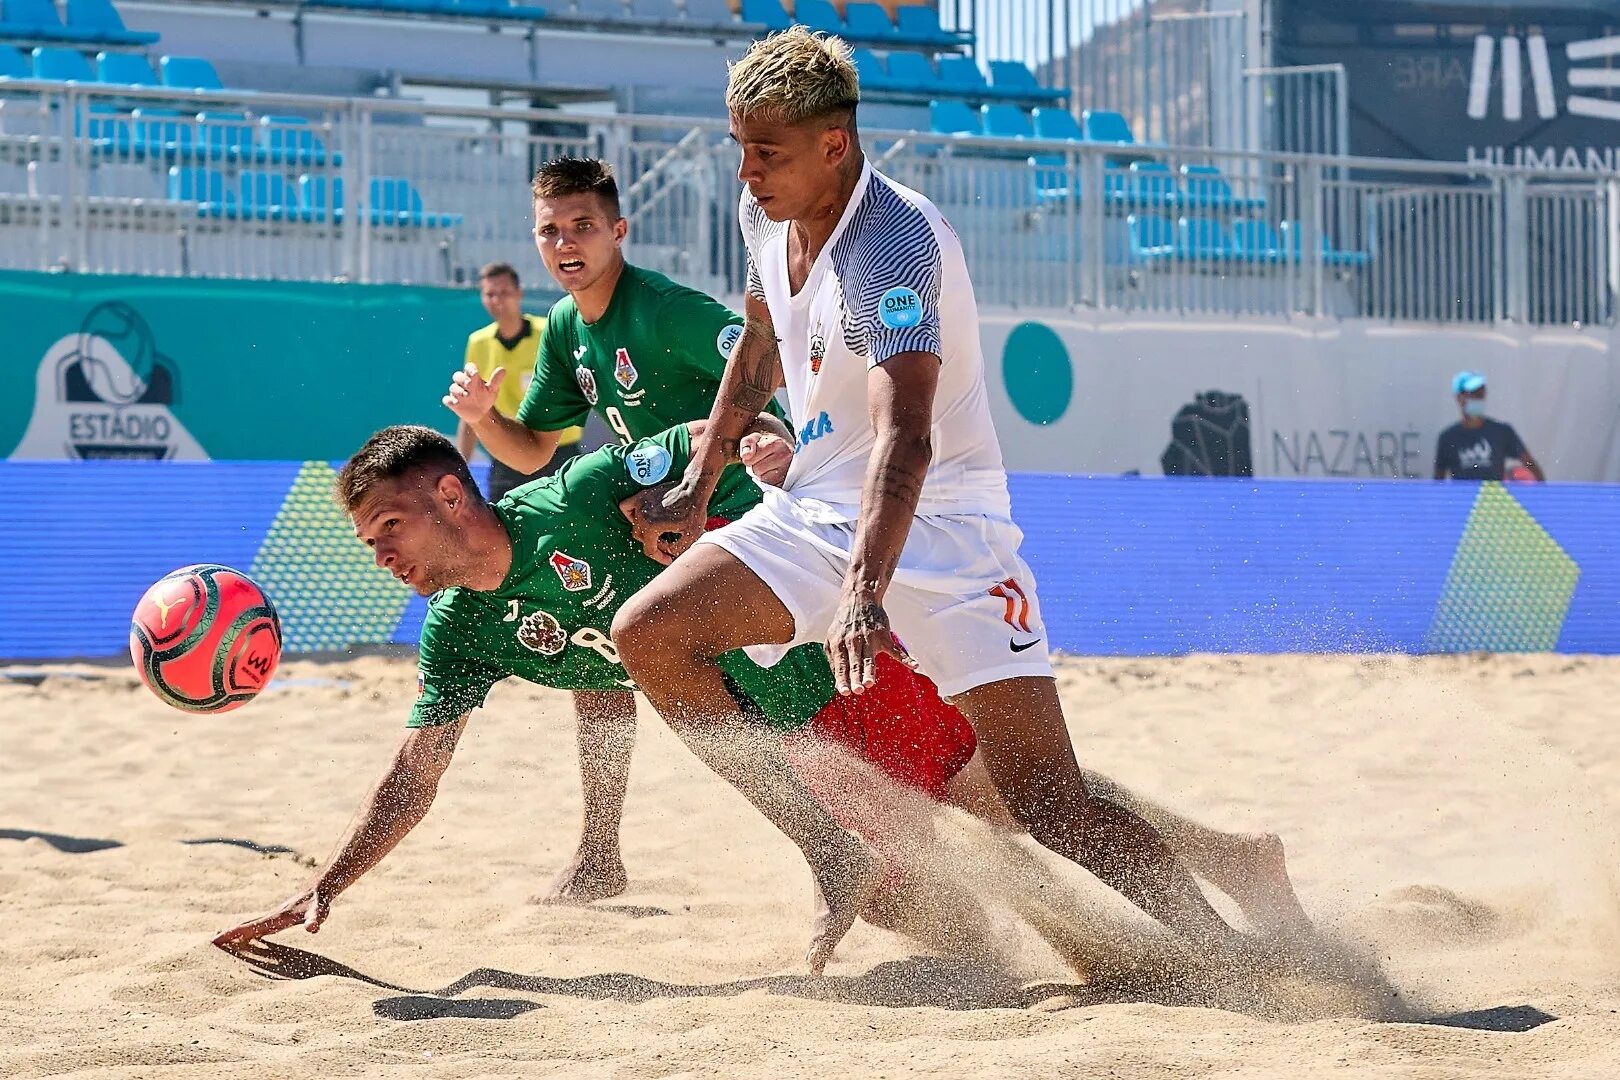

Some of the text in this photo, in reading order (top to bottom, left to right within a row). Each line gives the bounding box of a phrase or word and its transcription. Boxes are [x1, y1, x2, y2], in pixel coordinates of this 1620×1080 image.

[885, 294, 915, 309] ONE
[886, 305, 916, 314] HUMANITY
[721, 327, 740, 351] ONE
[632, 452, 647, 478] ONE
[570, 627, 621, 664] 8
